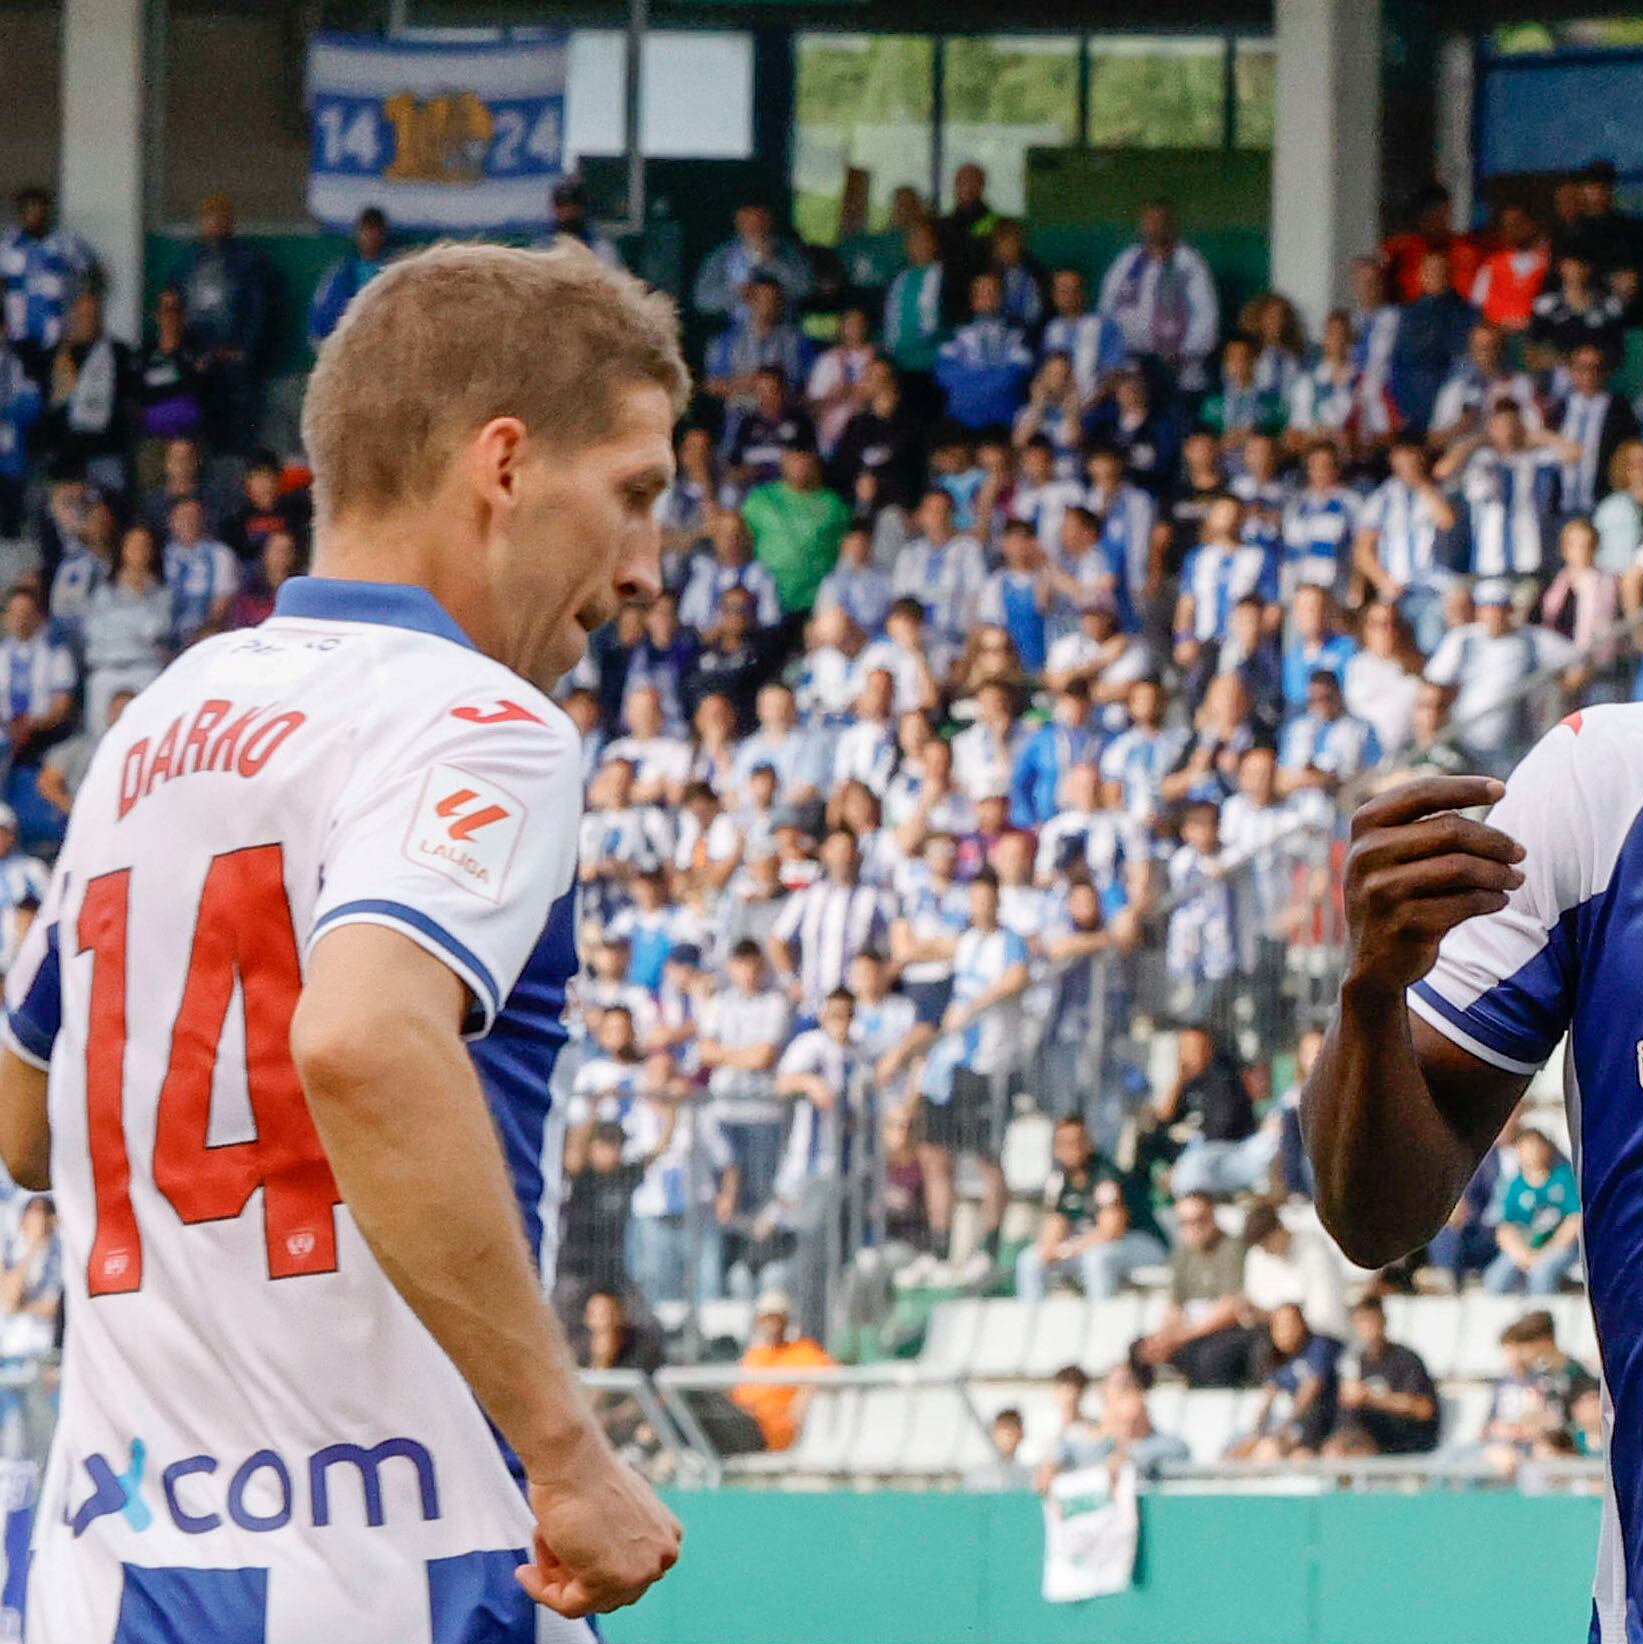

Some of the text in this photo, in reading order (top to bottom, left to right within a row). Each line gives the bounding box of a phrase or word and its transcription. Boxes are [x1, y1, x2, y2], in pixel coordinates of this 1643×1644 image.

[319, 105, 378, 167] 14
[117, 699, 306, 822] DARKO
[418, 837, 492, 885] LALIGA
[74, 842, 344, 1298] 14
